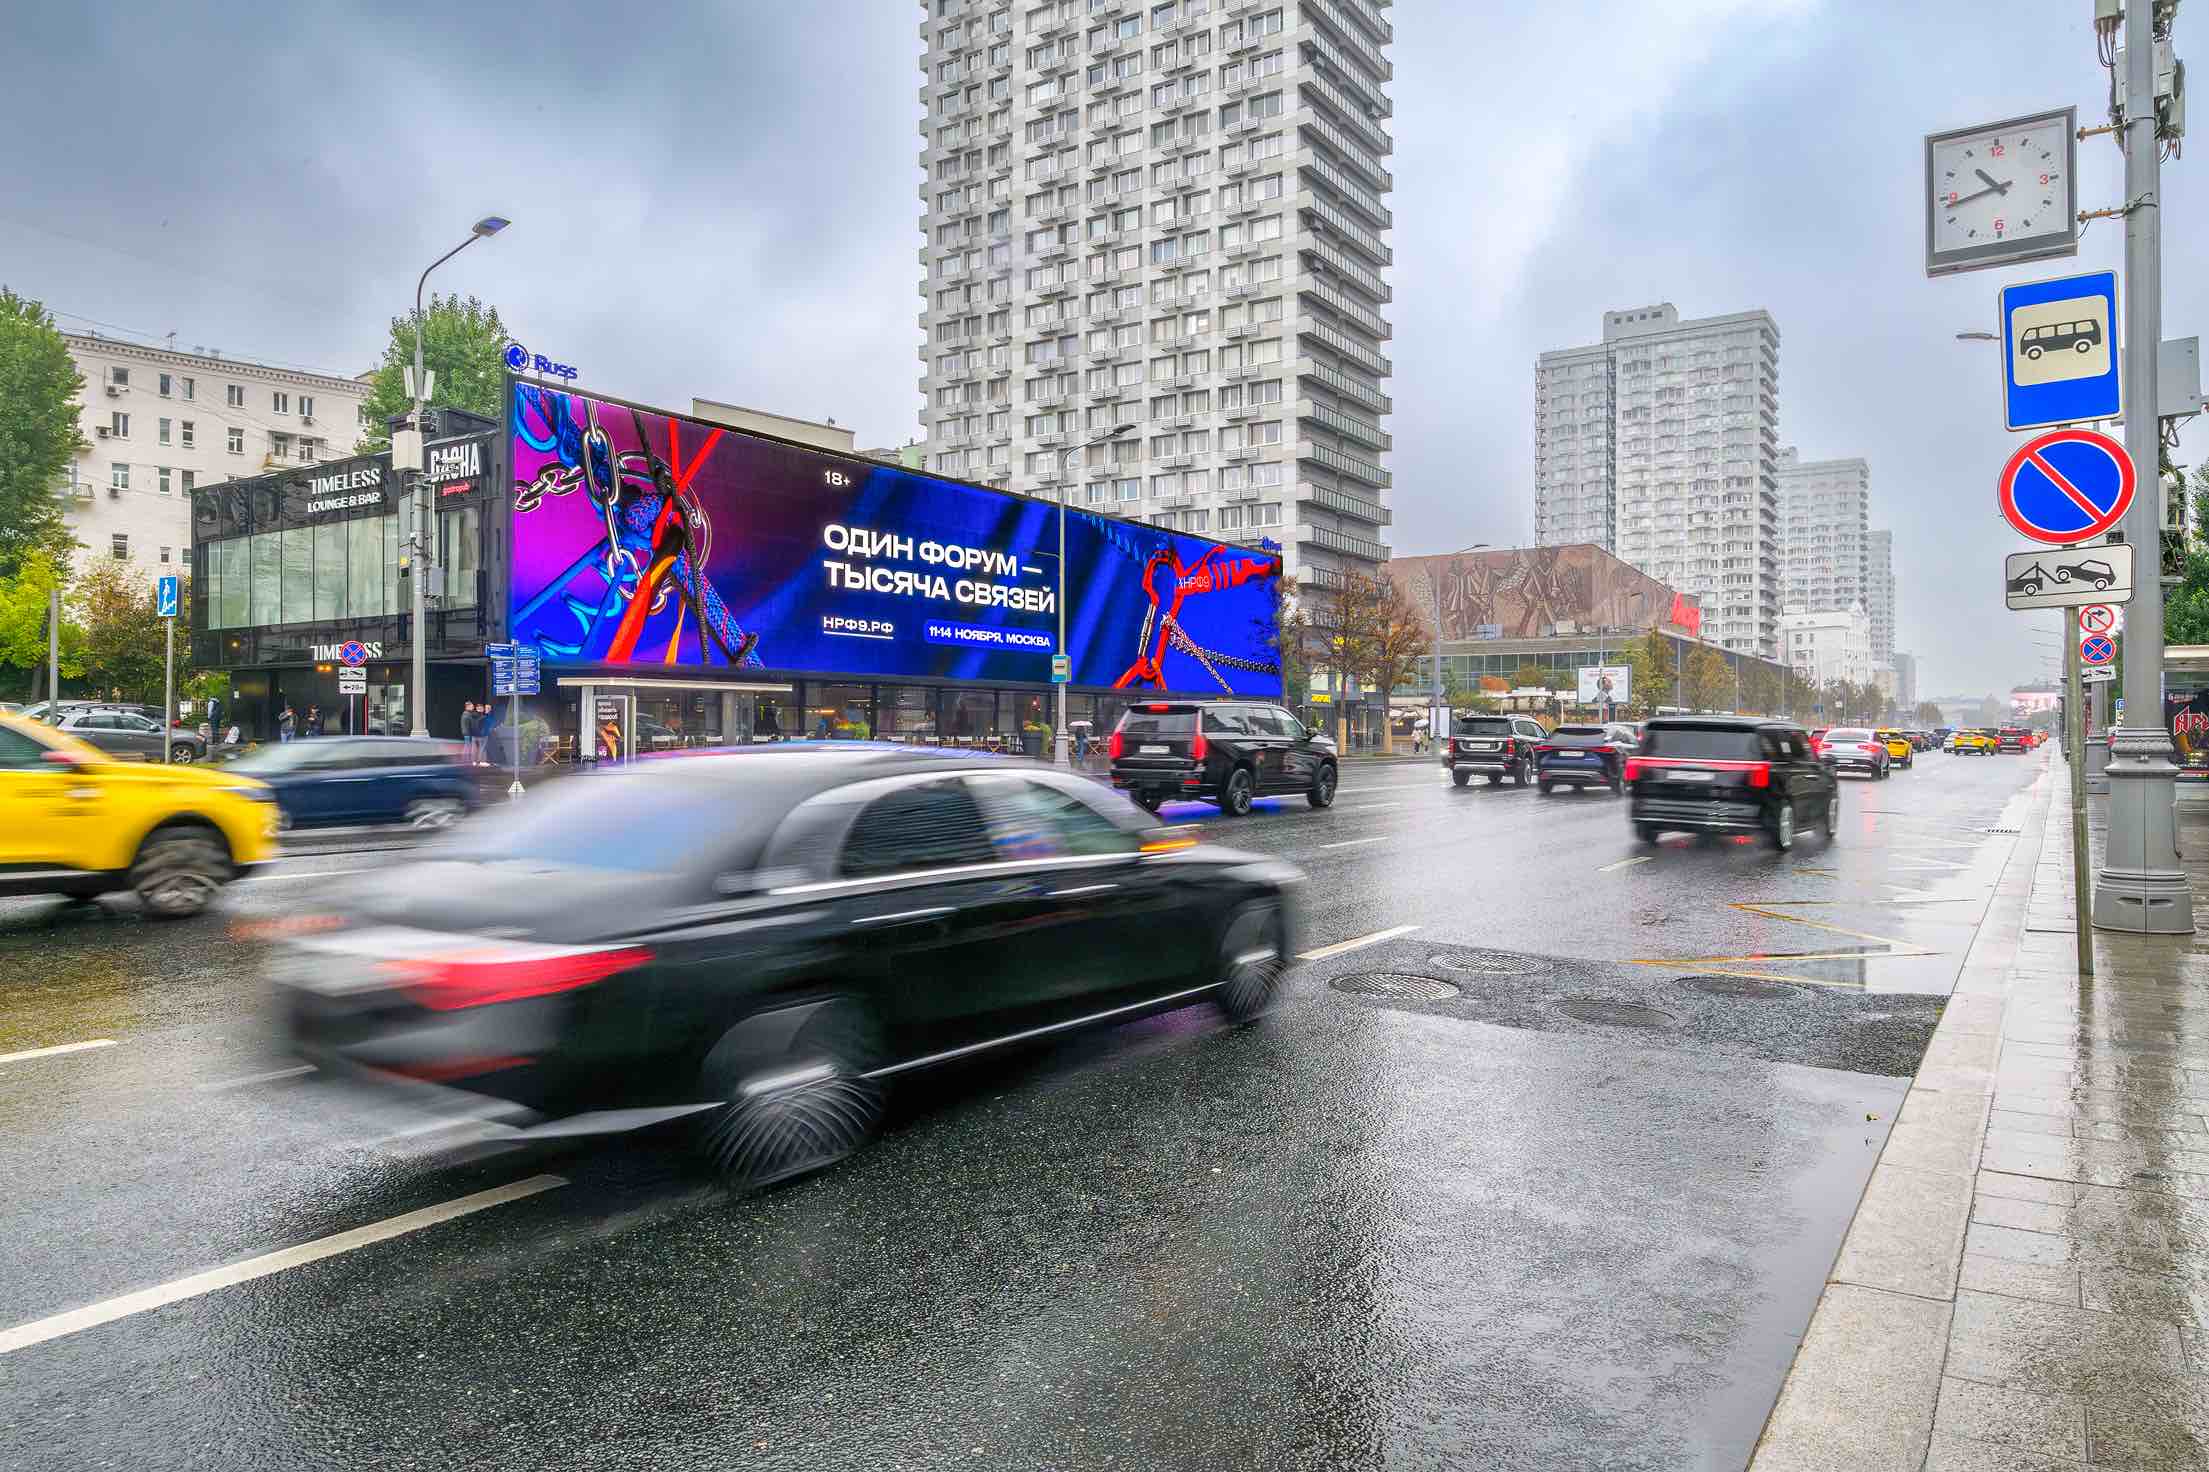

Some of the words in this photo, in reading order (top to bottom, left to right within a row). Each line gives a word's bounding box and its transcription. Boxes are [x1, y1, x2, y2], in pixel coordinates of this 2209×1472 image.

[1990, 145, 2005, 157] 12
[2039, 174, 2049, 185] 3
[1994, 219, 2005, 231] 6
[534, 353, 578, 380] Russ
[307, 468, 381, 495] TIMELESS
[824, 470, 852, 486] 18+
[307, 497, 349, 513] LOUNGE
[358, 491, 381, 505] BAR
[823, 524, 914, 561] ОДИН
[918, 540, 1018, 577] ФОРУМ
[823, 560, 951, 601] ТЫСЯЧА
[955, 579, 1055, 614] СВЯЗЕЙ
[823, 616, 894, 634] НРФ9.РФ
[1006, 633, 1051, 647] МОСКВА
[310, 641, 383, 661] TIMESS
